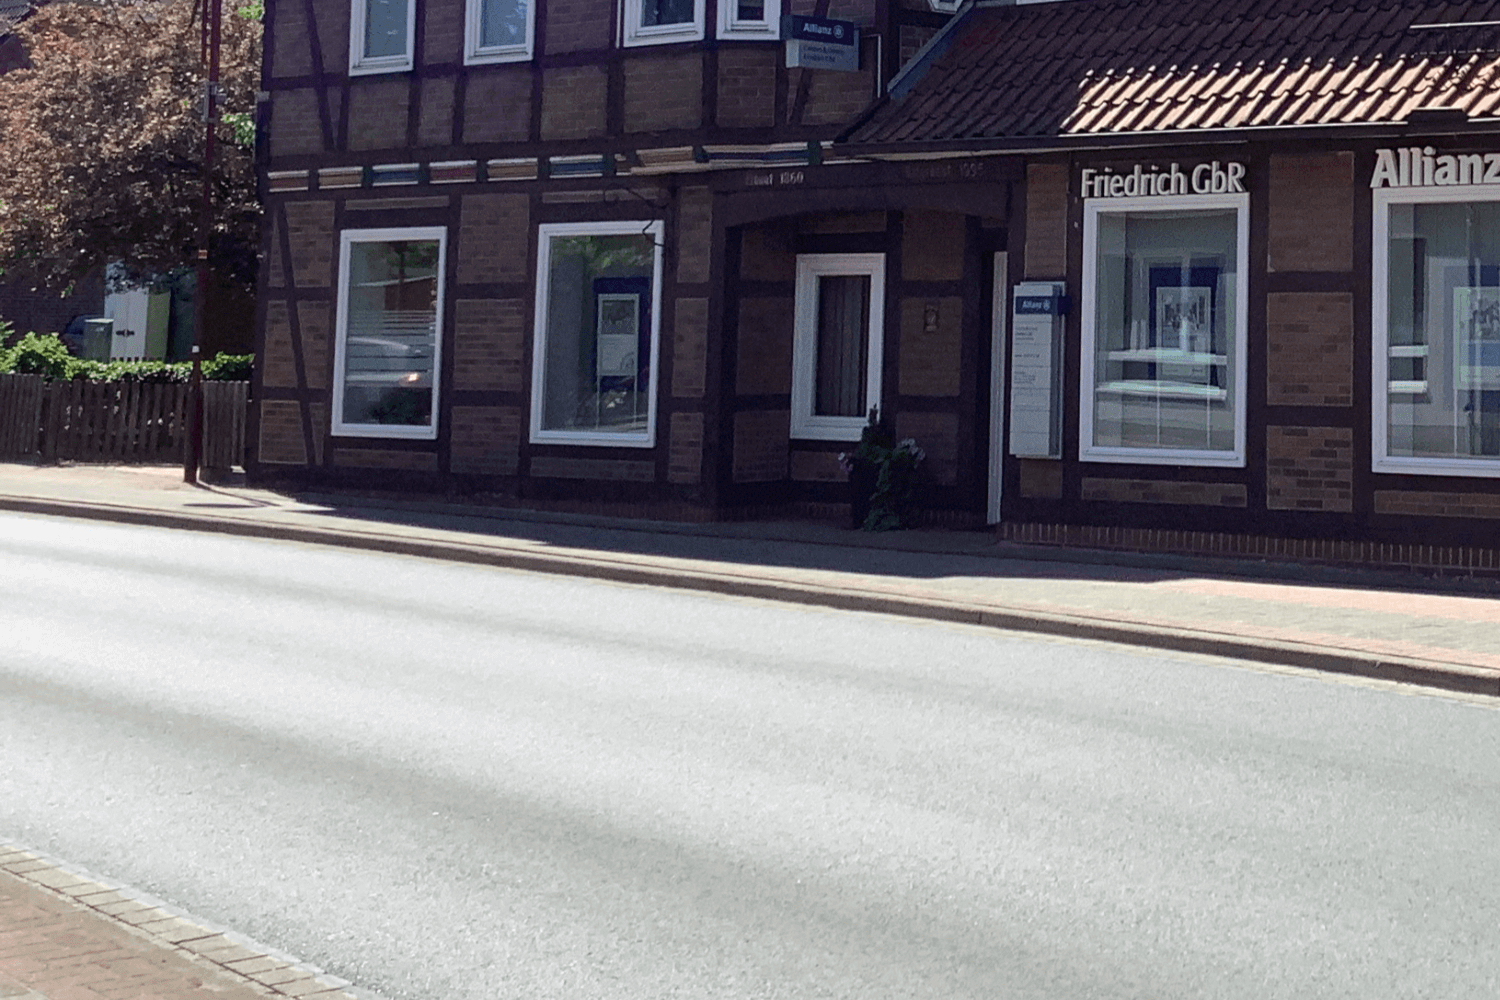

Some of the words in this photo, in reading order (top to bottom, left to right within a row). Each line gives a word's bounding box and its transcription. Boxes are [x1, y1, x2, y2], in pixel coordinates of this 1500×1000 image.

[803, 22, 832, 35] Allianz
[1081, 162, 1188, 198] Friedrich
[1191, 160, 1246, 194] GbR
